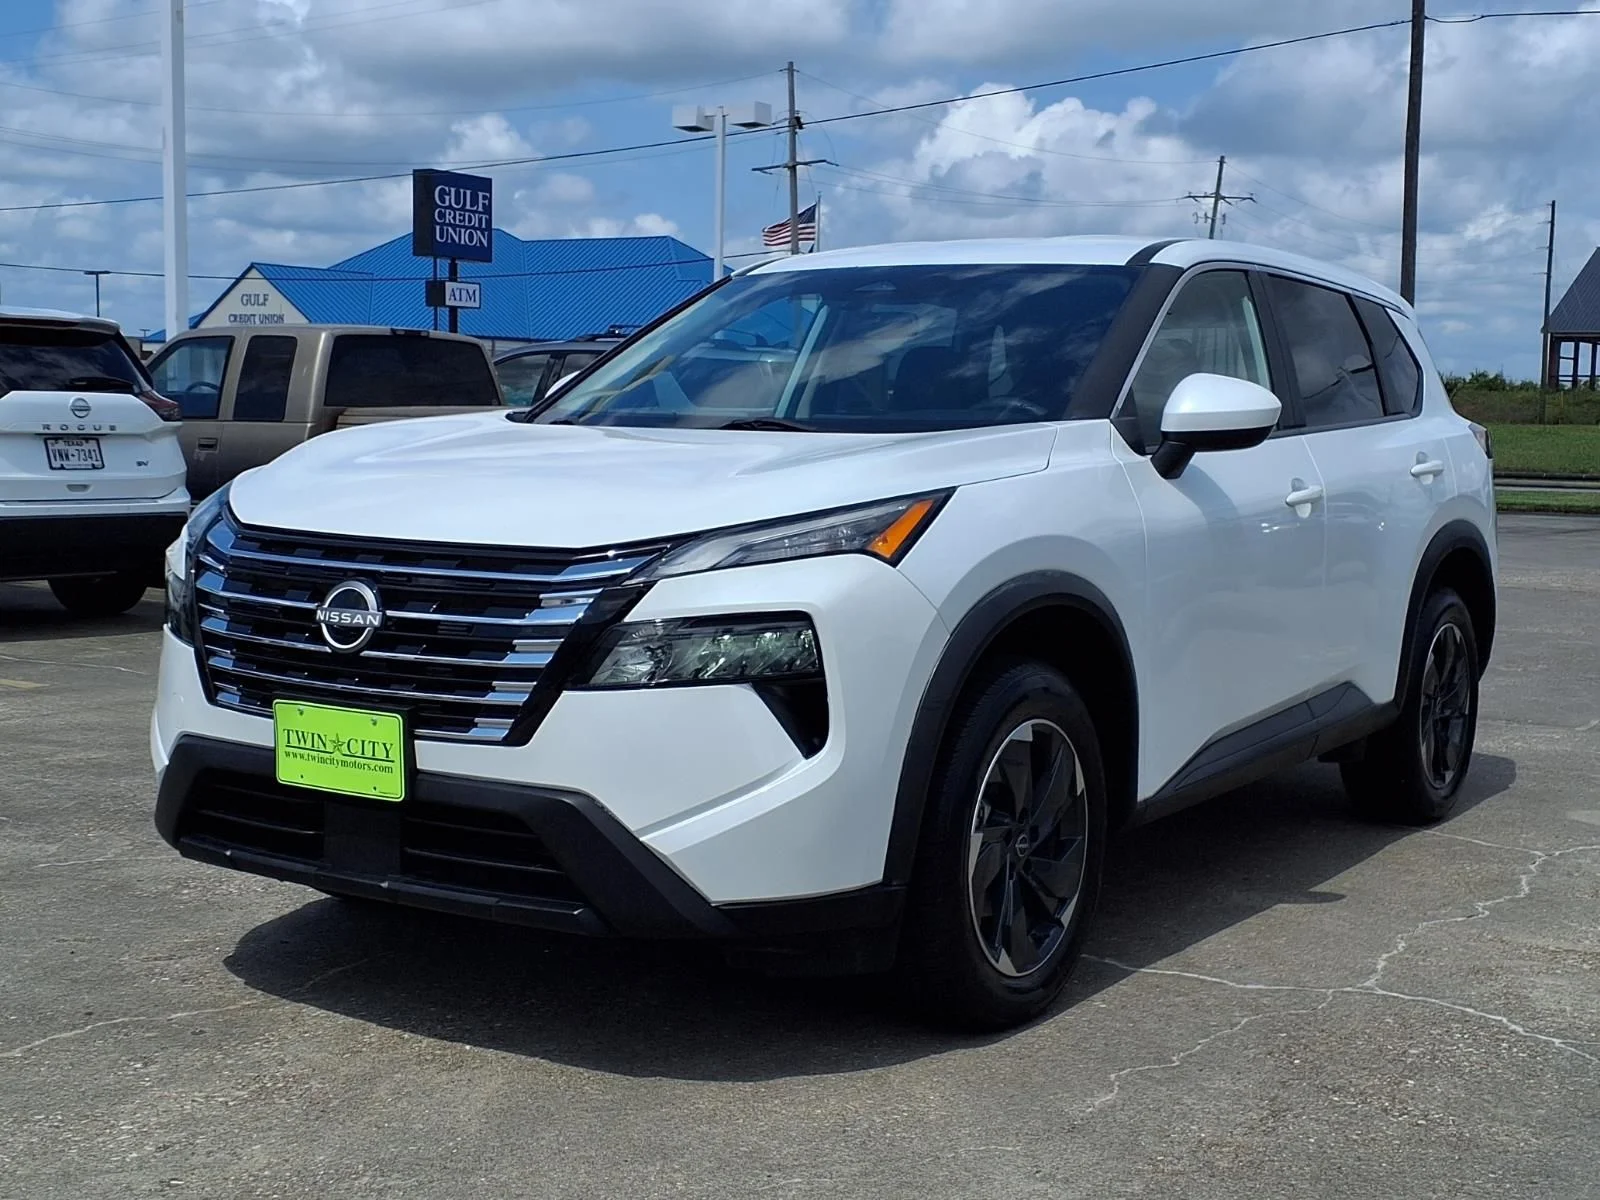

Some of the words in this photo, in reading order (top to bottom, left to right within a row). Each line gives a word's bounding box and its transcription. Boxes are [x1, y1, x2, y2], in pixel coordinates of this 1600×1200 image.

[434, 185, 490, 212] GULF
[434, 208, 489, 229] CREDIT
[435, 225, 489, 248] UNION
[241, 293, 269, 306] GULF
[449, 287, 477, 303] ATM
[228, 314, 256, 324] CREDIT
[259, 314, 284, 324] UNION
[316, 609, 381, 626] NISSAN
[283, 728, 328, 750] TWIN
[346, 737, 394, 759] CITY
[284, 750, 394, 774] www.twincitymotors.com
